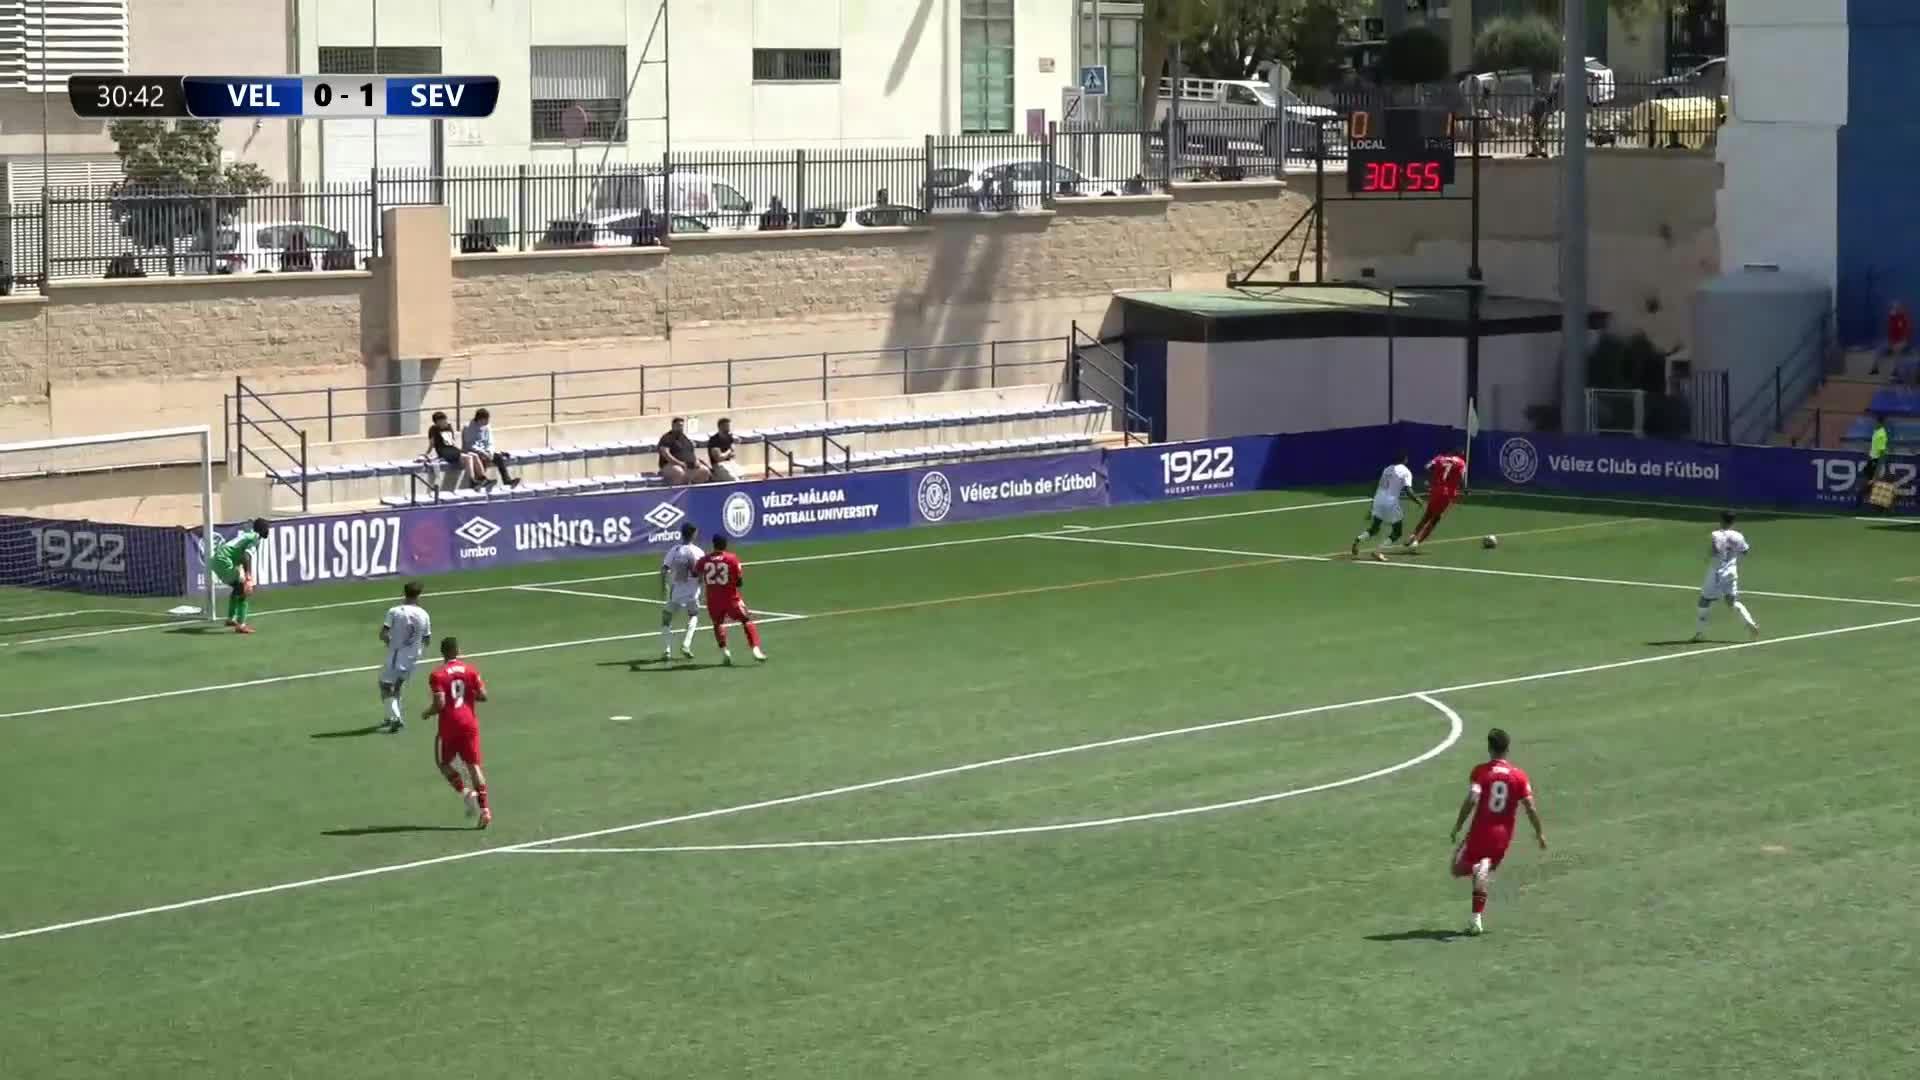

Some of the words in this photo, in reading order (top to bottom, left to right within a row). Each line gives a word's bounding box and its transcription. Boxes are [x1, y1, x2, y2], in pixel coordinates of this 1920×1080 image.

[1351, 112, 1368, 138] 0
[1350, 140, 1386, 150] LOCAL
[1362, 162, 1441, 190] 30:55
[1160, 446, 1234, 484] 1922
[1442, 463, 1454, 480] 7
[1549, 455, 1594, 472] Vélez
[1597, 458, 1637, 475] Club
[1640, 460, 1661, 477] de
[1665, 461, 1720, 480] Fútbol
[762, 488, 845, 508] VÉLEZ-MÁLAGA
[960, 482, 998, 502] Vélez
[1000, 479, 1033, 498] Club
[1034, 477, 1052, 493] de
[1055, 472, 1097, 492] Fútbol
[762, 512, 816, 527] FOOTBALL
[817, 504, 879, 520] UNIVERSITY
[514, 514, 632, 551] umbro.es
[648, 530, 682, 543] umbro
[32, 527, 126, 572] 1922
[237, 516, 401, 586] MPULSO27
[460, 546, 497, 559] umbro
[704, 562, 729, 586] 23
[451, 679, 465, 708] 9
[1488, 780, 1508, 813] 8
